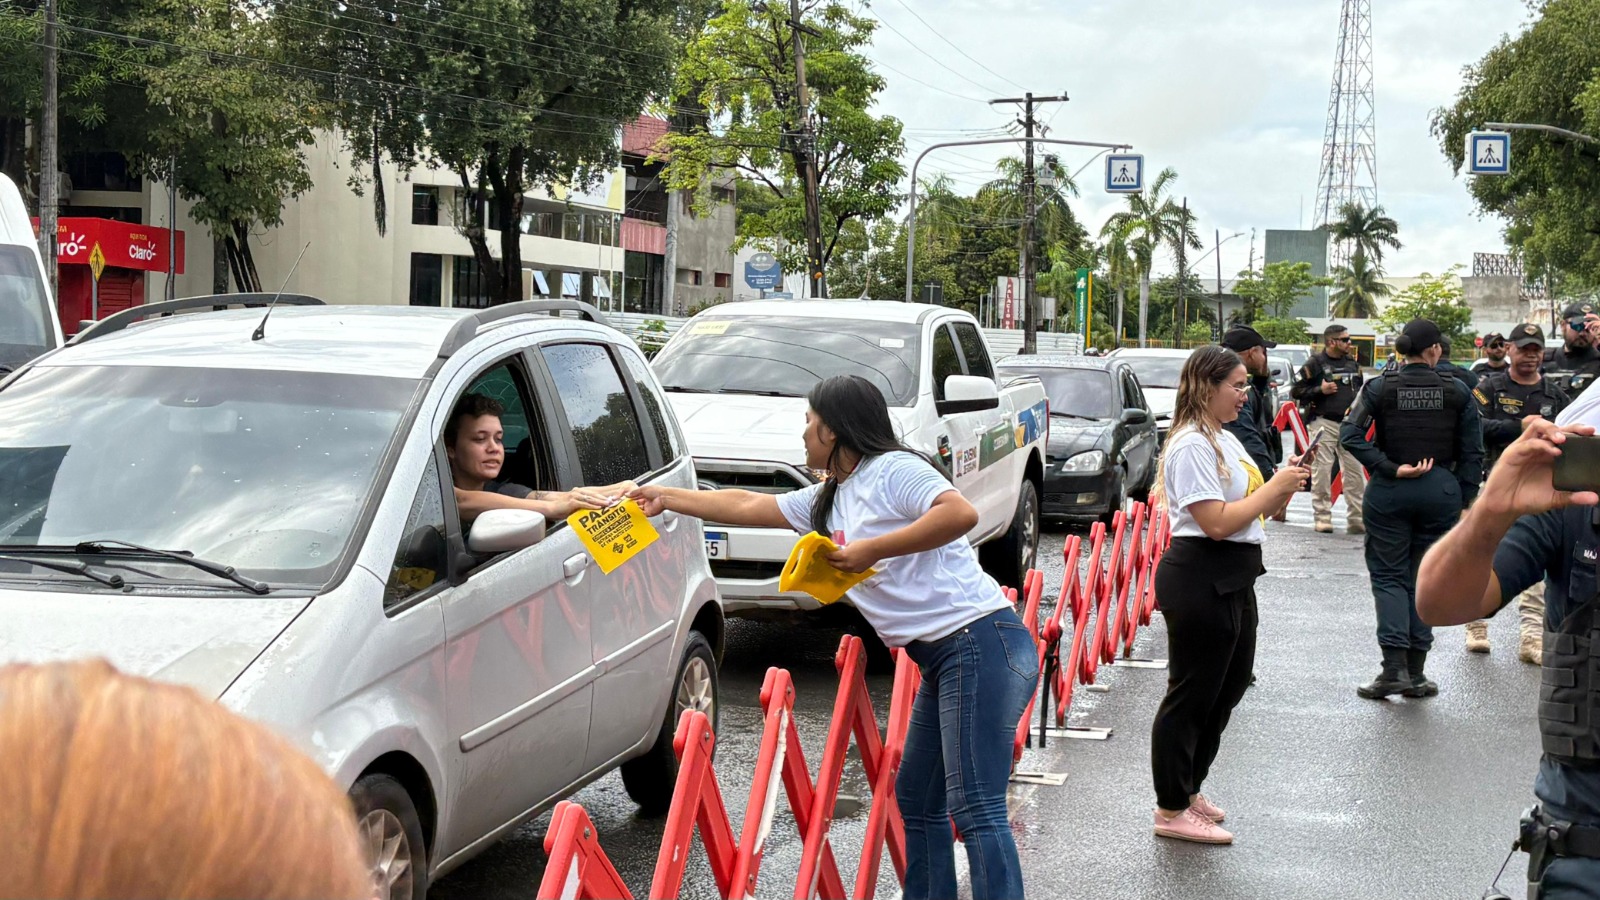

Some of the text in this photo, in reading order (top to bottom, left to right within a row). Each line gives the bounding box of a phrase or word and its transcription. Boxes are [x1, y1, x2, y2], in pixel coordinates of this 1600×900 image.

[129, 243, 154, 261] Claro
[1399, 389, 1441, 400] POLÍCIA
[1398, 400, 1441, 409] MILITAR
[579, 506, 610, 528] PAZ
[586, 505, 626, 535] TRÂNSITO
